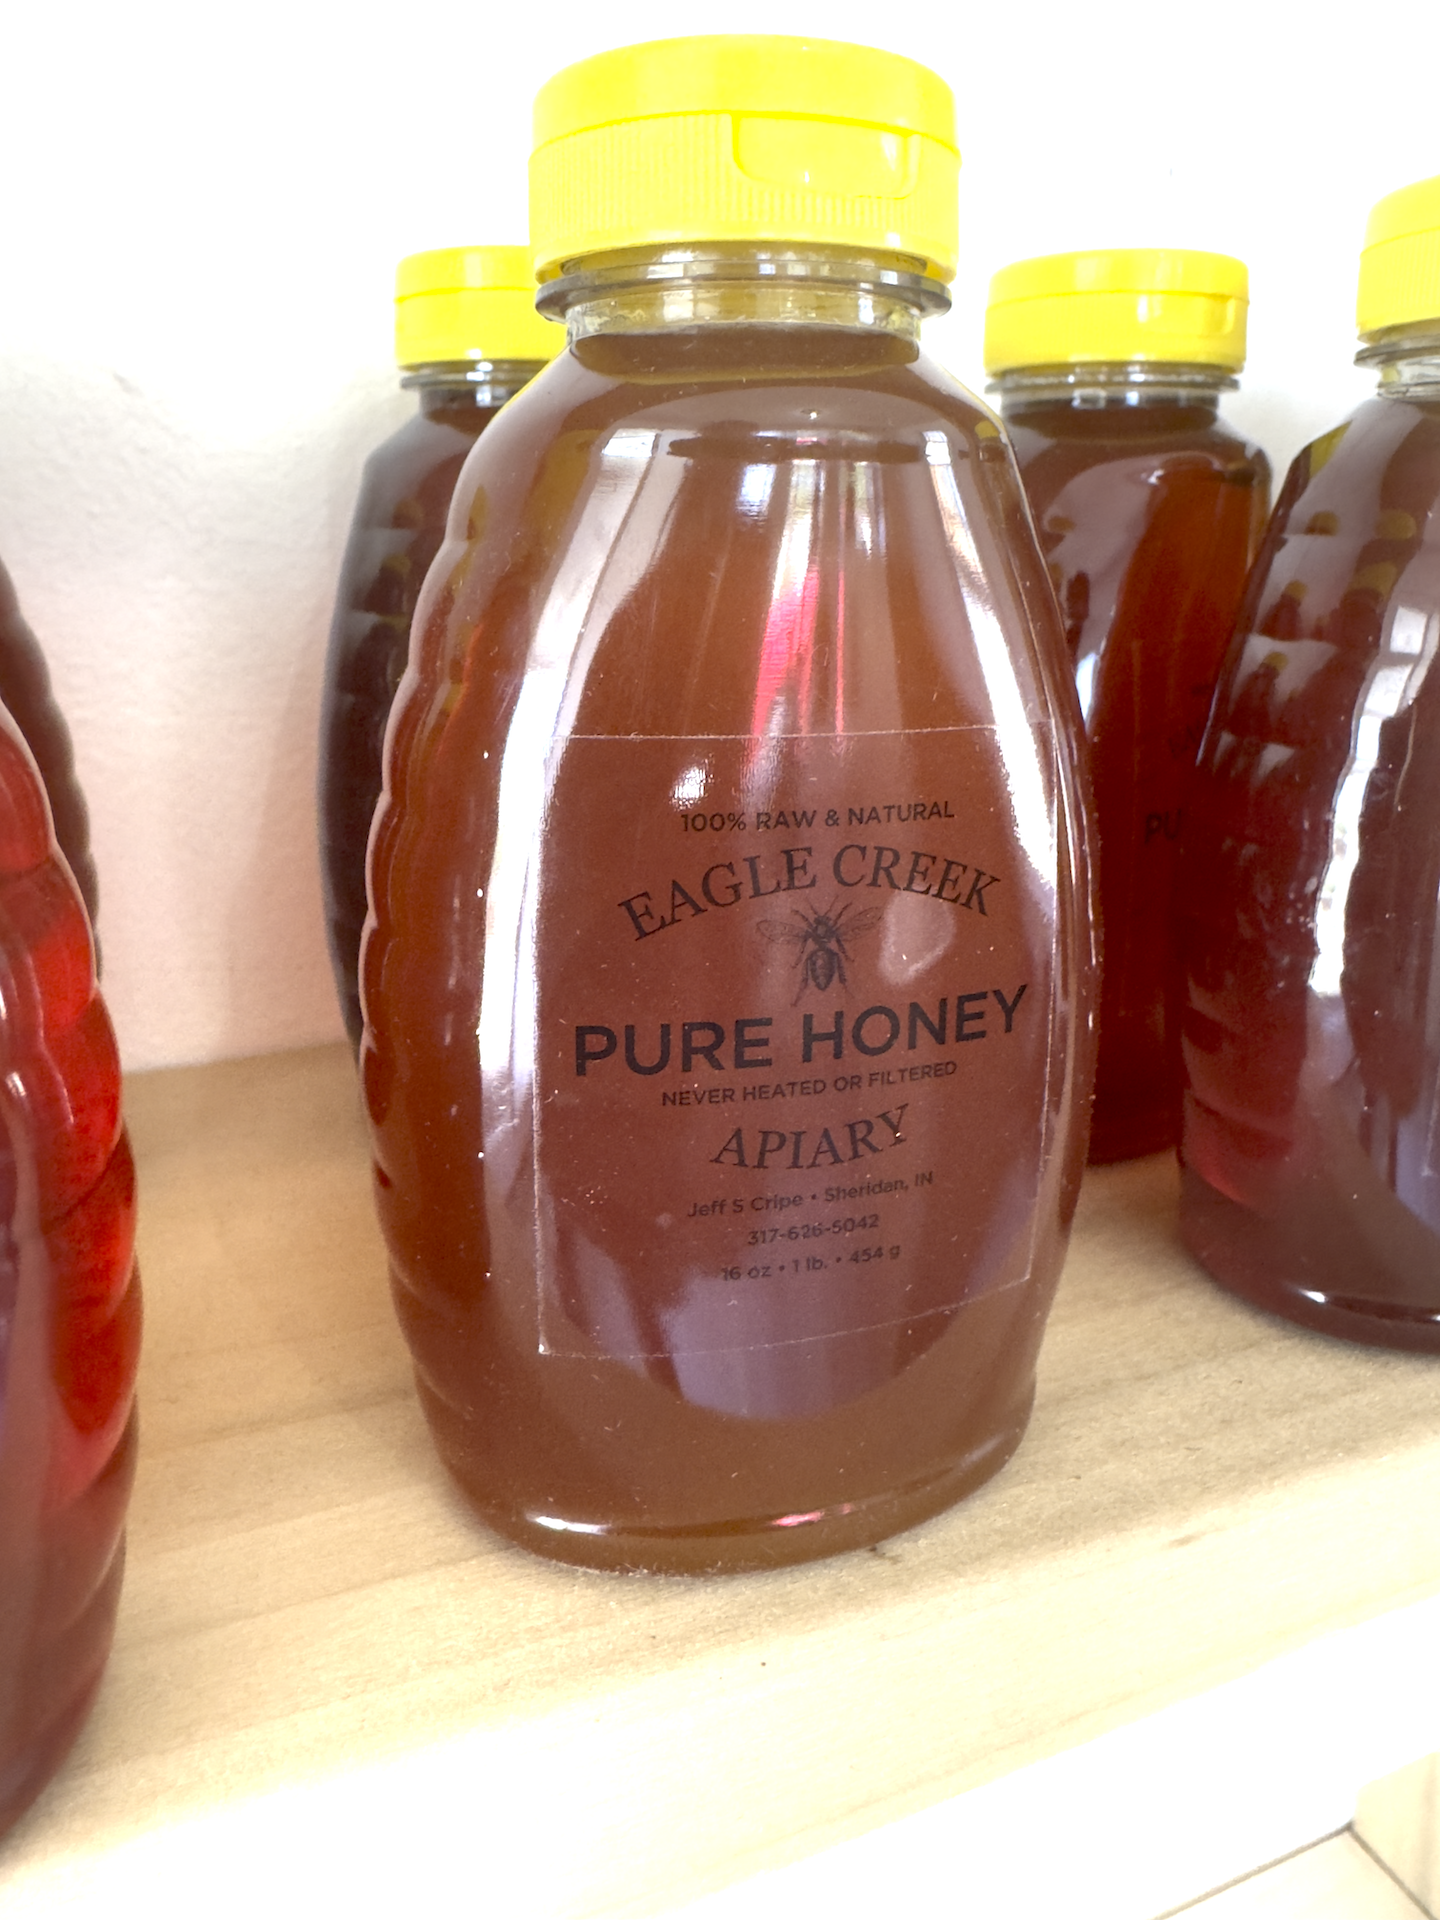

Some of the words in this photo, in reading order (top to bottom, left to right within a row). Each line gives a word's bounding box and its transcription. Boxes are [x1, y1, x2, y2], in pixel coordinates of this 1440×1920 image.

[681, 811, 746, 832] 100%
[756, 809, 816, 830] RAW
[824, 809, 840, 827] &
[848, 801, 955, 825] NATURAL
[618, 846, 817, 941] EAGLE
[832, 844, 1001, 915] CREEK
[575, 1017, 773, 1076] PURE
[802, 984, 1028, 1064] HONEY
[662, 1087, 735, 1107] NEVER
[743, 1079, 826, 1102] HEATED
[834, 1075, 862, 1092] OR
[868, 1061, 957, 1087] FILTERED
[710, 1103, 910, 1170] APIARY
[687, 1200, 727, 1218] Jeff
[732, 1198, 744, 1214] S
[751, 1193, 803, 1212] Cripe
[824, 1179, 909, 1202] Sheridan,
[914, 1171, 934, 1187] IN
[748, 1213, 880, 1246] 317-626-5042
[722, 1266, 742, 1281] 16
[747, 1265, 772, 1279] oz
[791, 1259, 800, 1273] 1
[806, 1256, 828, 1271] lb.
[849, 1246, 883, 1264] 454
[889, 1245, 901, 1260] g
